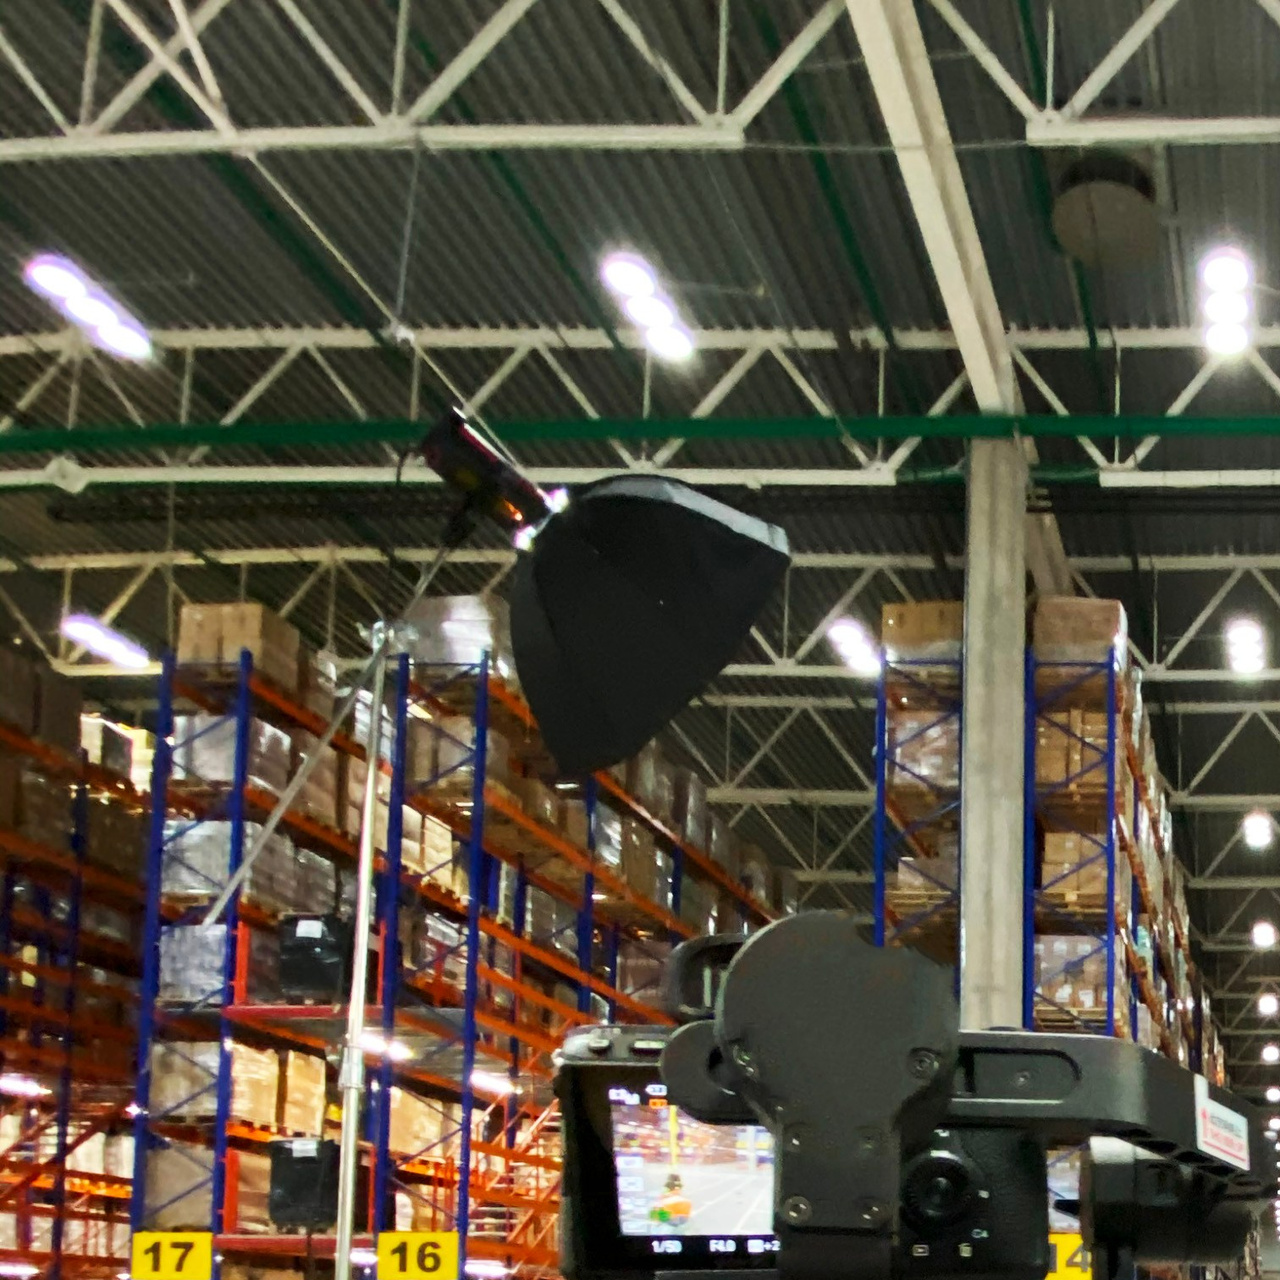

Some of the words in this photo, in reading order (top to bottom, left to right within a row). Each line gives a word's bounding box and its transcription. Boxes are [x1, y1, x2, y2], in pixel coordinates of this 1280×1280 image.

[144, 1241, 194, 1273] 17
[391, 1241, 441, 1273] 16
[1047, 1243, 1093, 1274] 14
